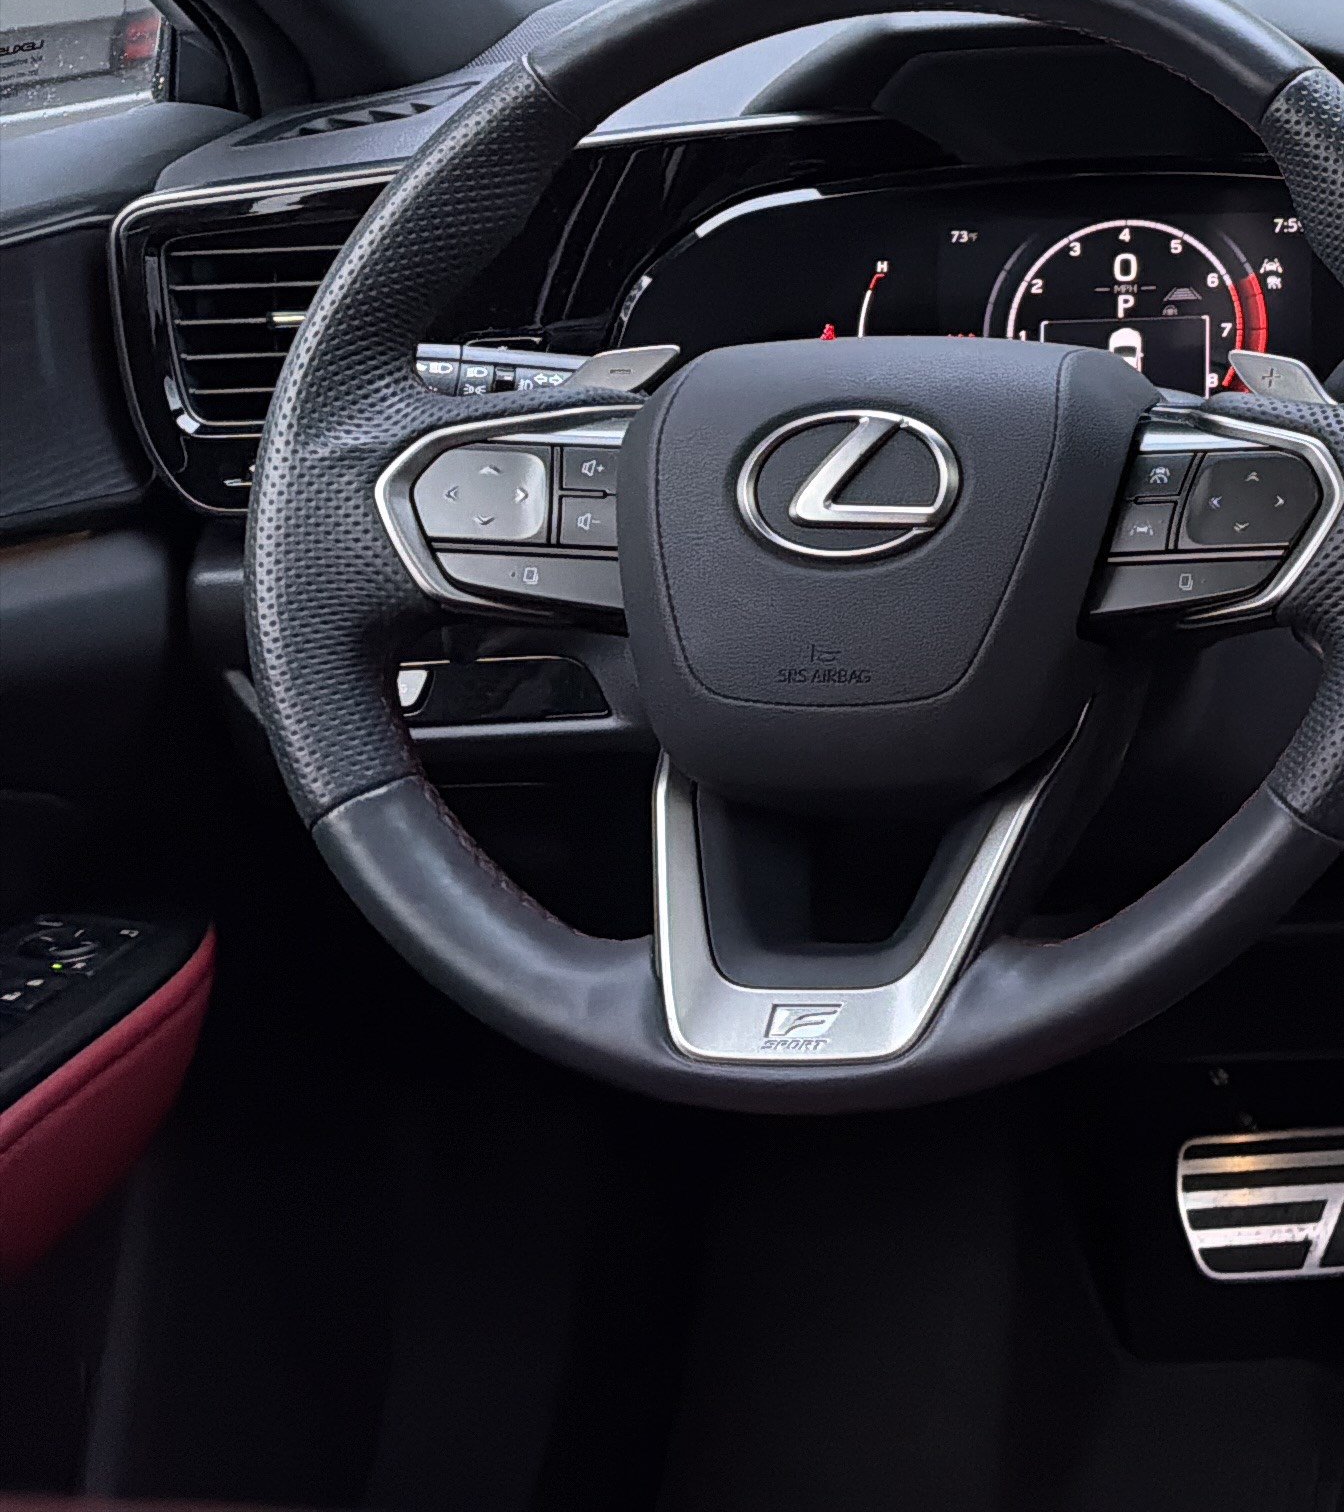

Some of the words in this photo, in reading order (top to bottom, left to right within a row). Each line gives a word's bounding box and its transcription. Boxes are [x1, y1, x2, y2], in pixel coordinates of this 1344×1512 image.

[1118, 228, 1131, 243] 4
[1069, 241, 1082, 256] 3
[1169, 239, 1183, 254] 5
[876, 260, 889, 273] H
[1113, 252, 1138, 282] 0
[1030, 278, 1043, 294] 2
[1206, 273, 1218, 287] 6
[1113, 283, 1138, 294] MPH
[1117, 294, 1135, 318] P
[1220, 322, 1233, 338] 7
[1207, 372, 1219, 388] 8
[778, 669, 807, 683] SRS
[811, 669, 872, 683] AIRBAG
[760, 1039, 828, 1051] SPORT
